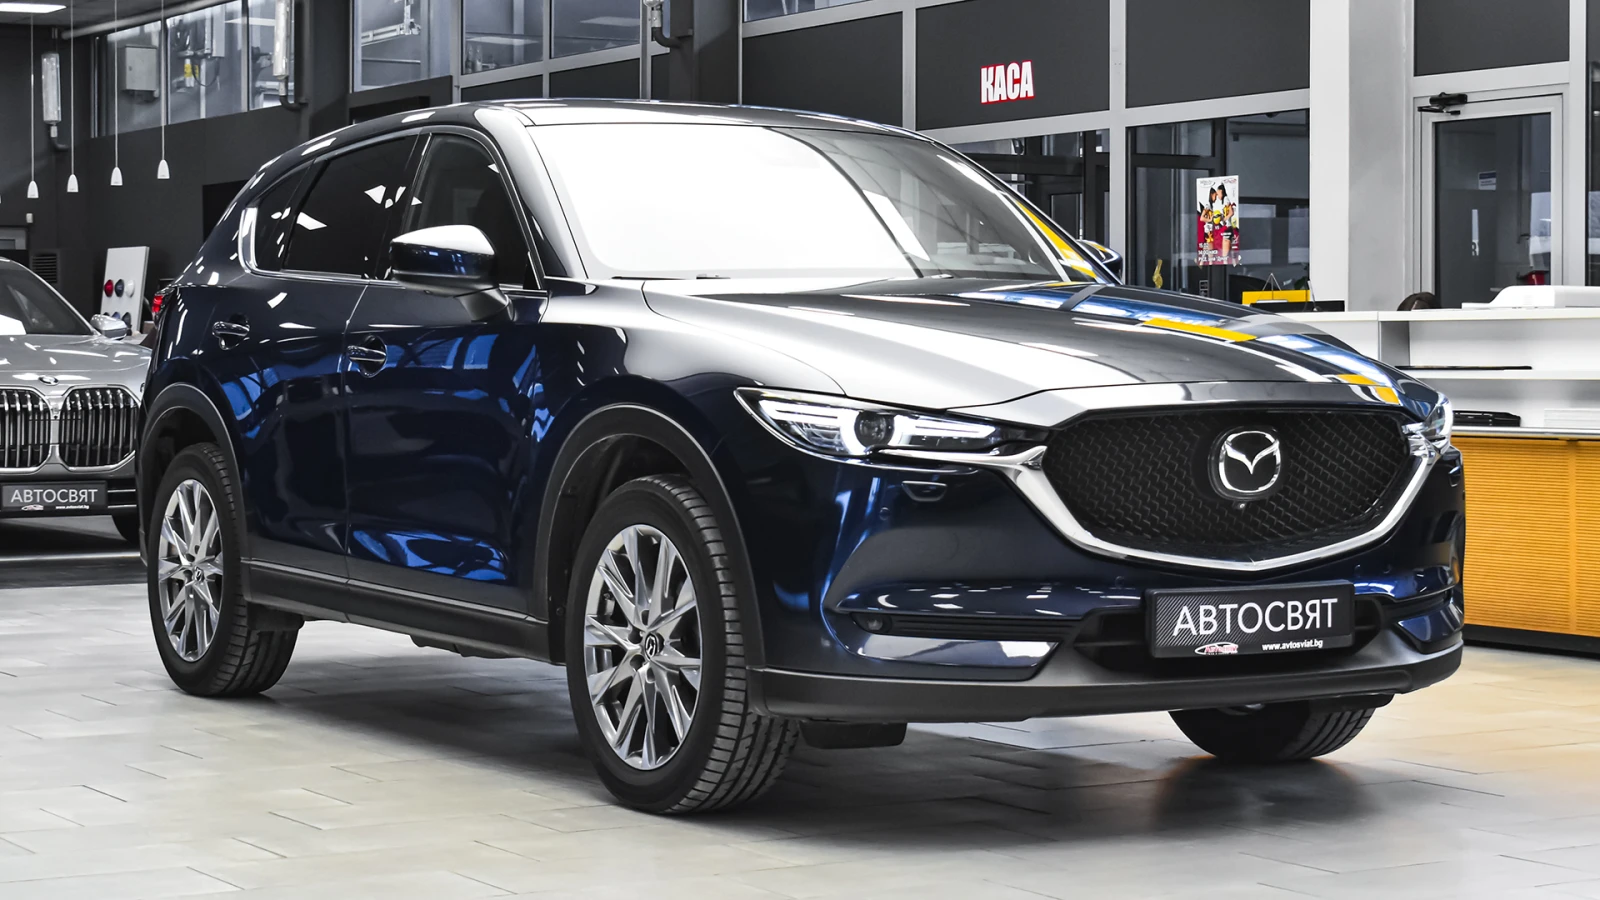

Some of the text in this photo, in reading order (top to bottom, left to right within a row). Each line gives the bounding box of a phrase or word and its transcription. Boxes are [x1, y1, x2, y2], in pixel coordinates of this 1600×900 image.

[980, 60, 1035, 104] КАСА
[10, 489, 98, 503] АВТОСВЯТ
[1172, 598, 1338, 637] АВТОСВЯТ
[1262, 639, 1323, 651] www.avtosviat.bg
